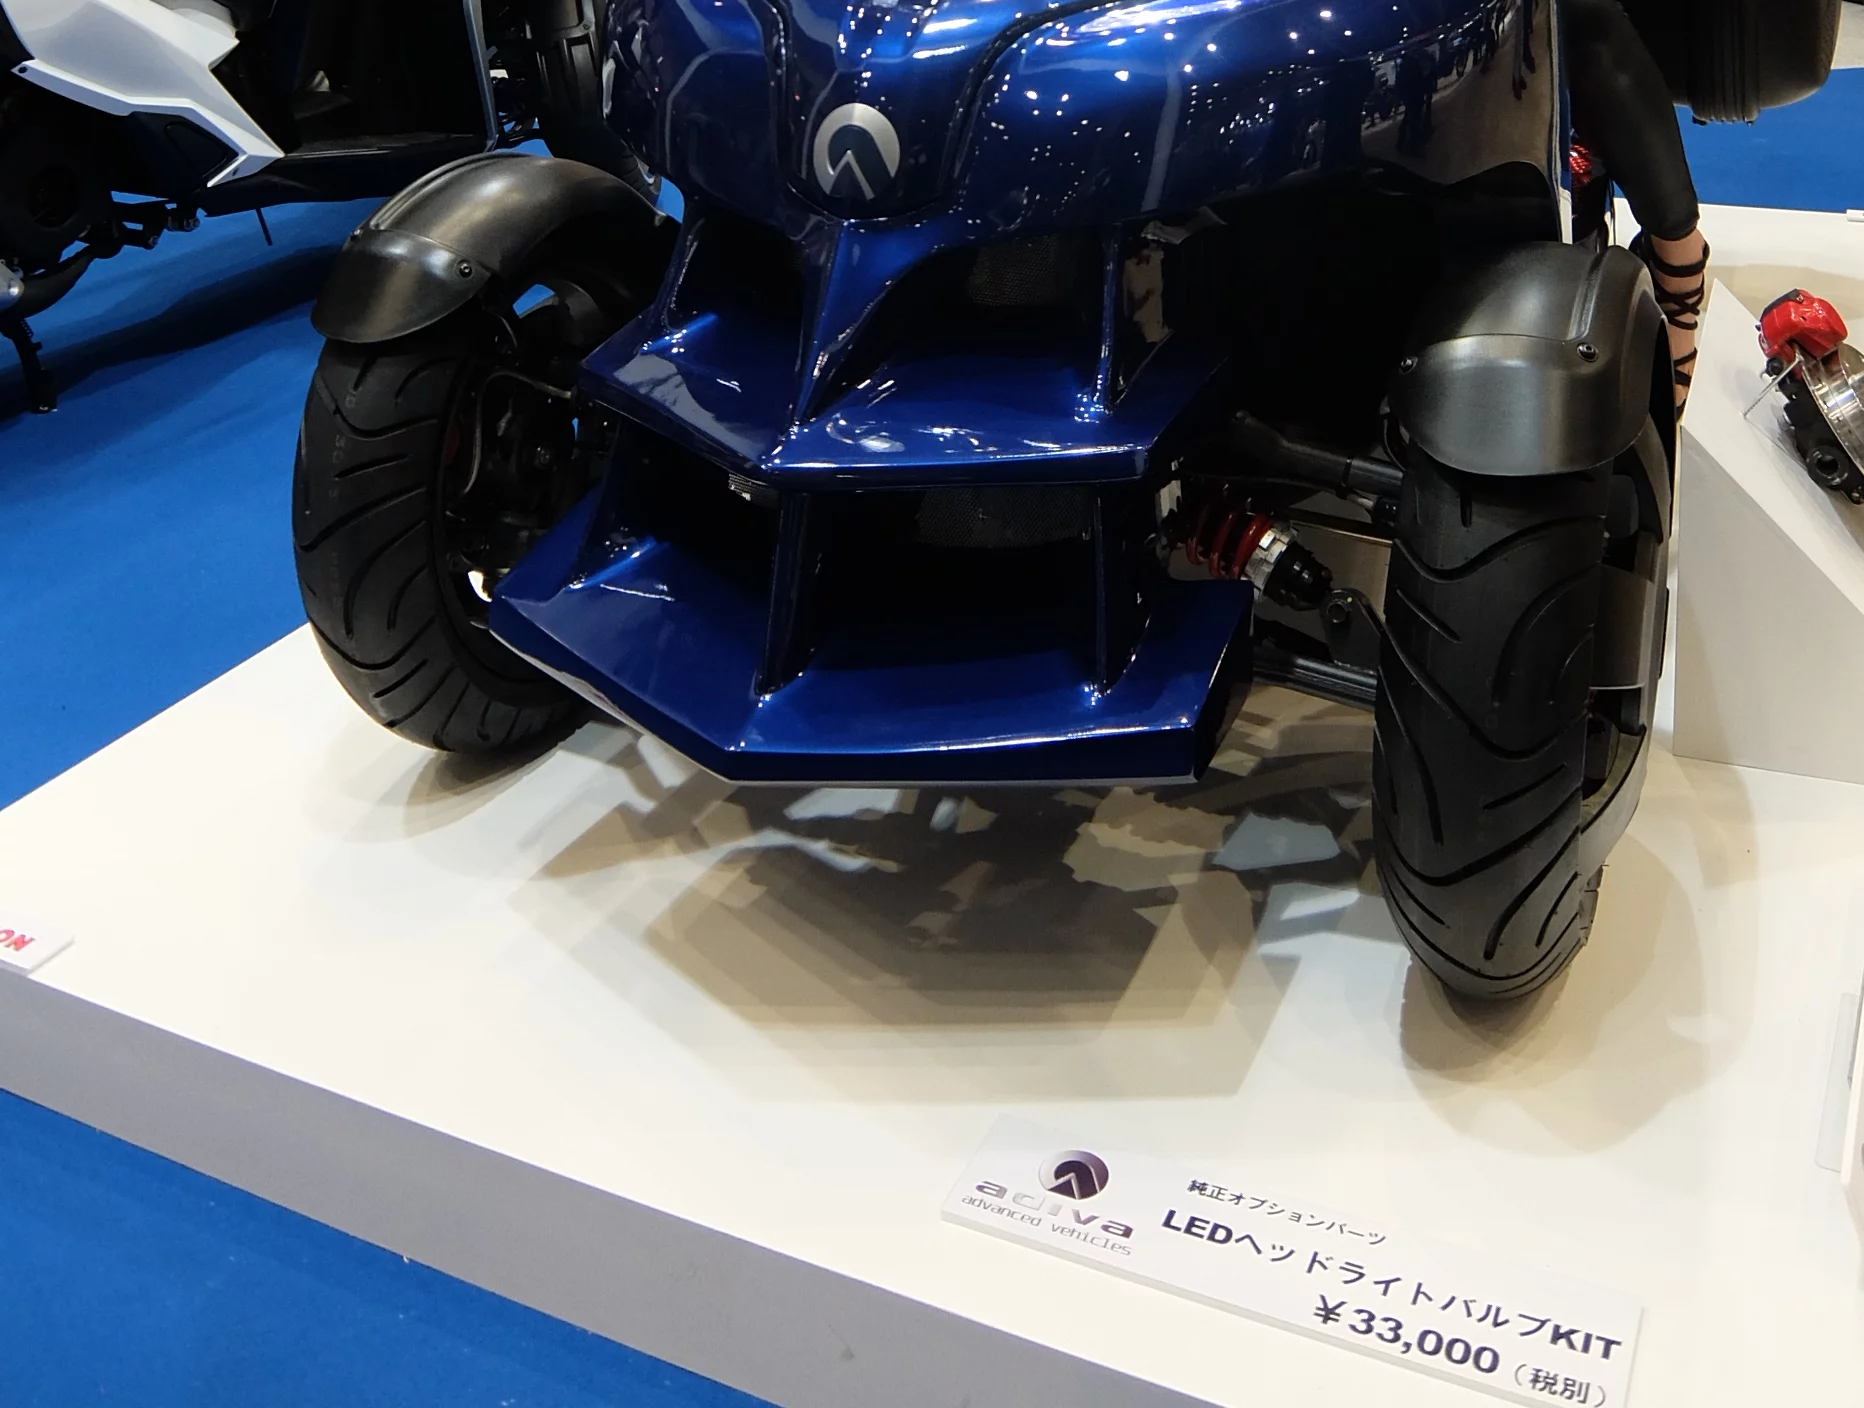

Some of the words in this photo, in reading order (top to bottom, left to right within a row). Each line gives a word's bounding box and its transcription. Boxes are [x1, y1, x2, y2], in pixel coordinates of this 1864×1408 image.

[961, 1194, 1043, 1228] advanced
[1051, 1222, 1133, 1257] vehicles
[975, 1180, 1135, 1239] adiva
[1313, 1293, 1501, 1375] ¥33,000
